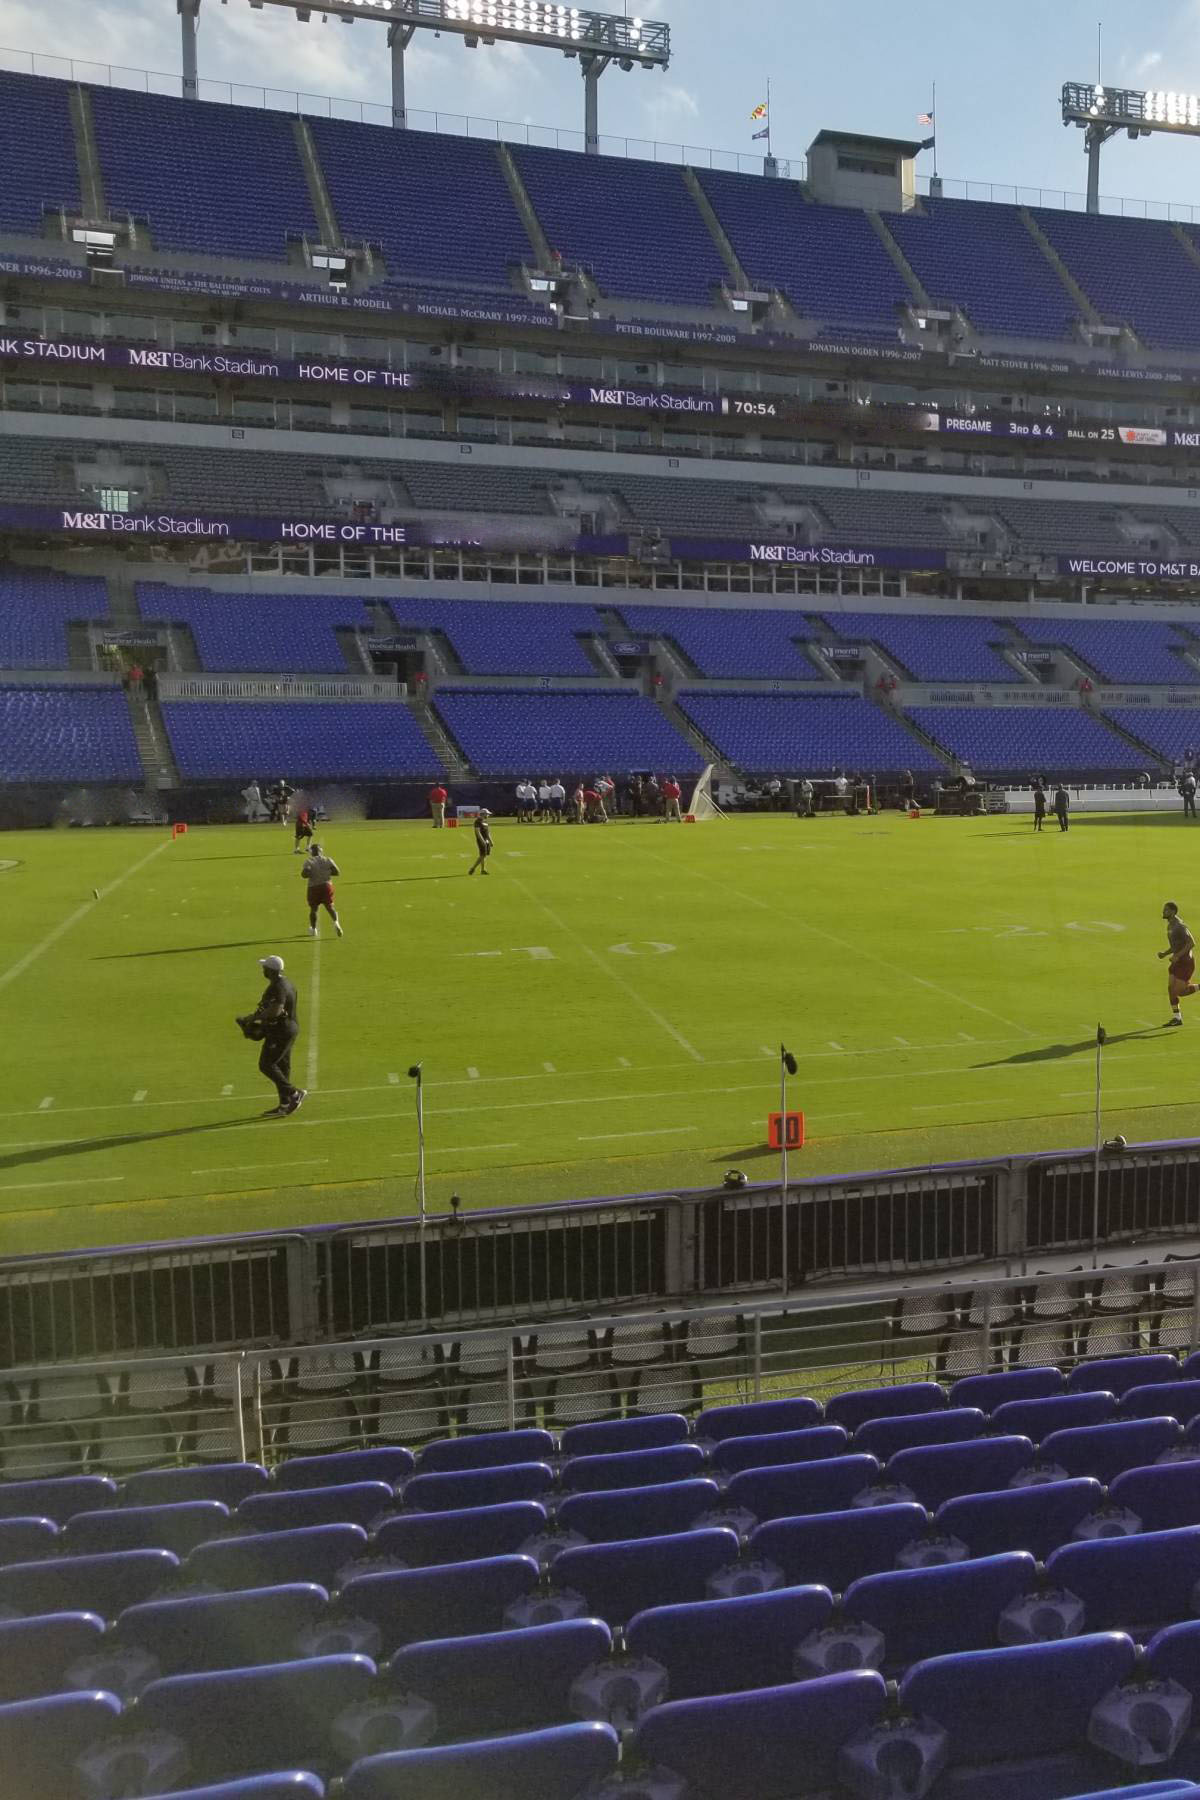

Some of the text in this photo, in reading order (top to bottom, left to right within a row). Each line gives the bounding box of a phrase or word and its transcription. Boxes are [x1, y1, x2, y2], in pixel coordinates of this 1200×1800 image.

[24, 264, 82, 279] 1996-2003
[299, 293, 339, 305] ARTHUR
[353, 299, 392, 310] MODELL
[417, 304, 458, 317] MICHAEL
[505, 313, 553, 326] 1997-2002
[616, 324, 642, 334] PETER
[644, 327, 690, 339] BOULWARE
[24, 341, 105, 360] STADIUM
[809, 343, 850, 354] JONATHAN
[852, 347, 879, 357] OGDEN
[128, 349, 279, 376] M&T Bank Stadium
[299, 365, 411, 386] HOME OF THE
[590, 388, 625, 405] M&T
[626, 391, 659, 407] Bank
[660, 394, 714, 412] Stadium
[734, 401, 776, 415] 70:54
[946, 418, 992, 432] PREGAME
[1032, 424, 1042, 435] &
[1045, 425, 1054, 436] 4
[1067, 428, 1115, 440] BALL ON 25
[62, 511, 229, 536] M&T Bank Stadium
[281, 522, 406, 542] HOME OF THE
[750, 544, 875, 565] M&T Bank Stadium
[1069, 560, 1136, 574] WELCOME
[1138, 562, 1157, 575] TO
[1160, 563, 1187, 576] M&T
[774, 1116, 800, 1145] 10
